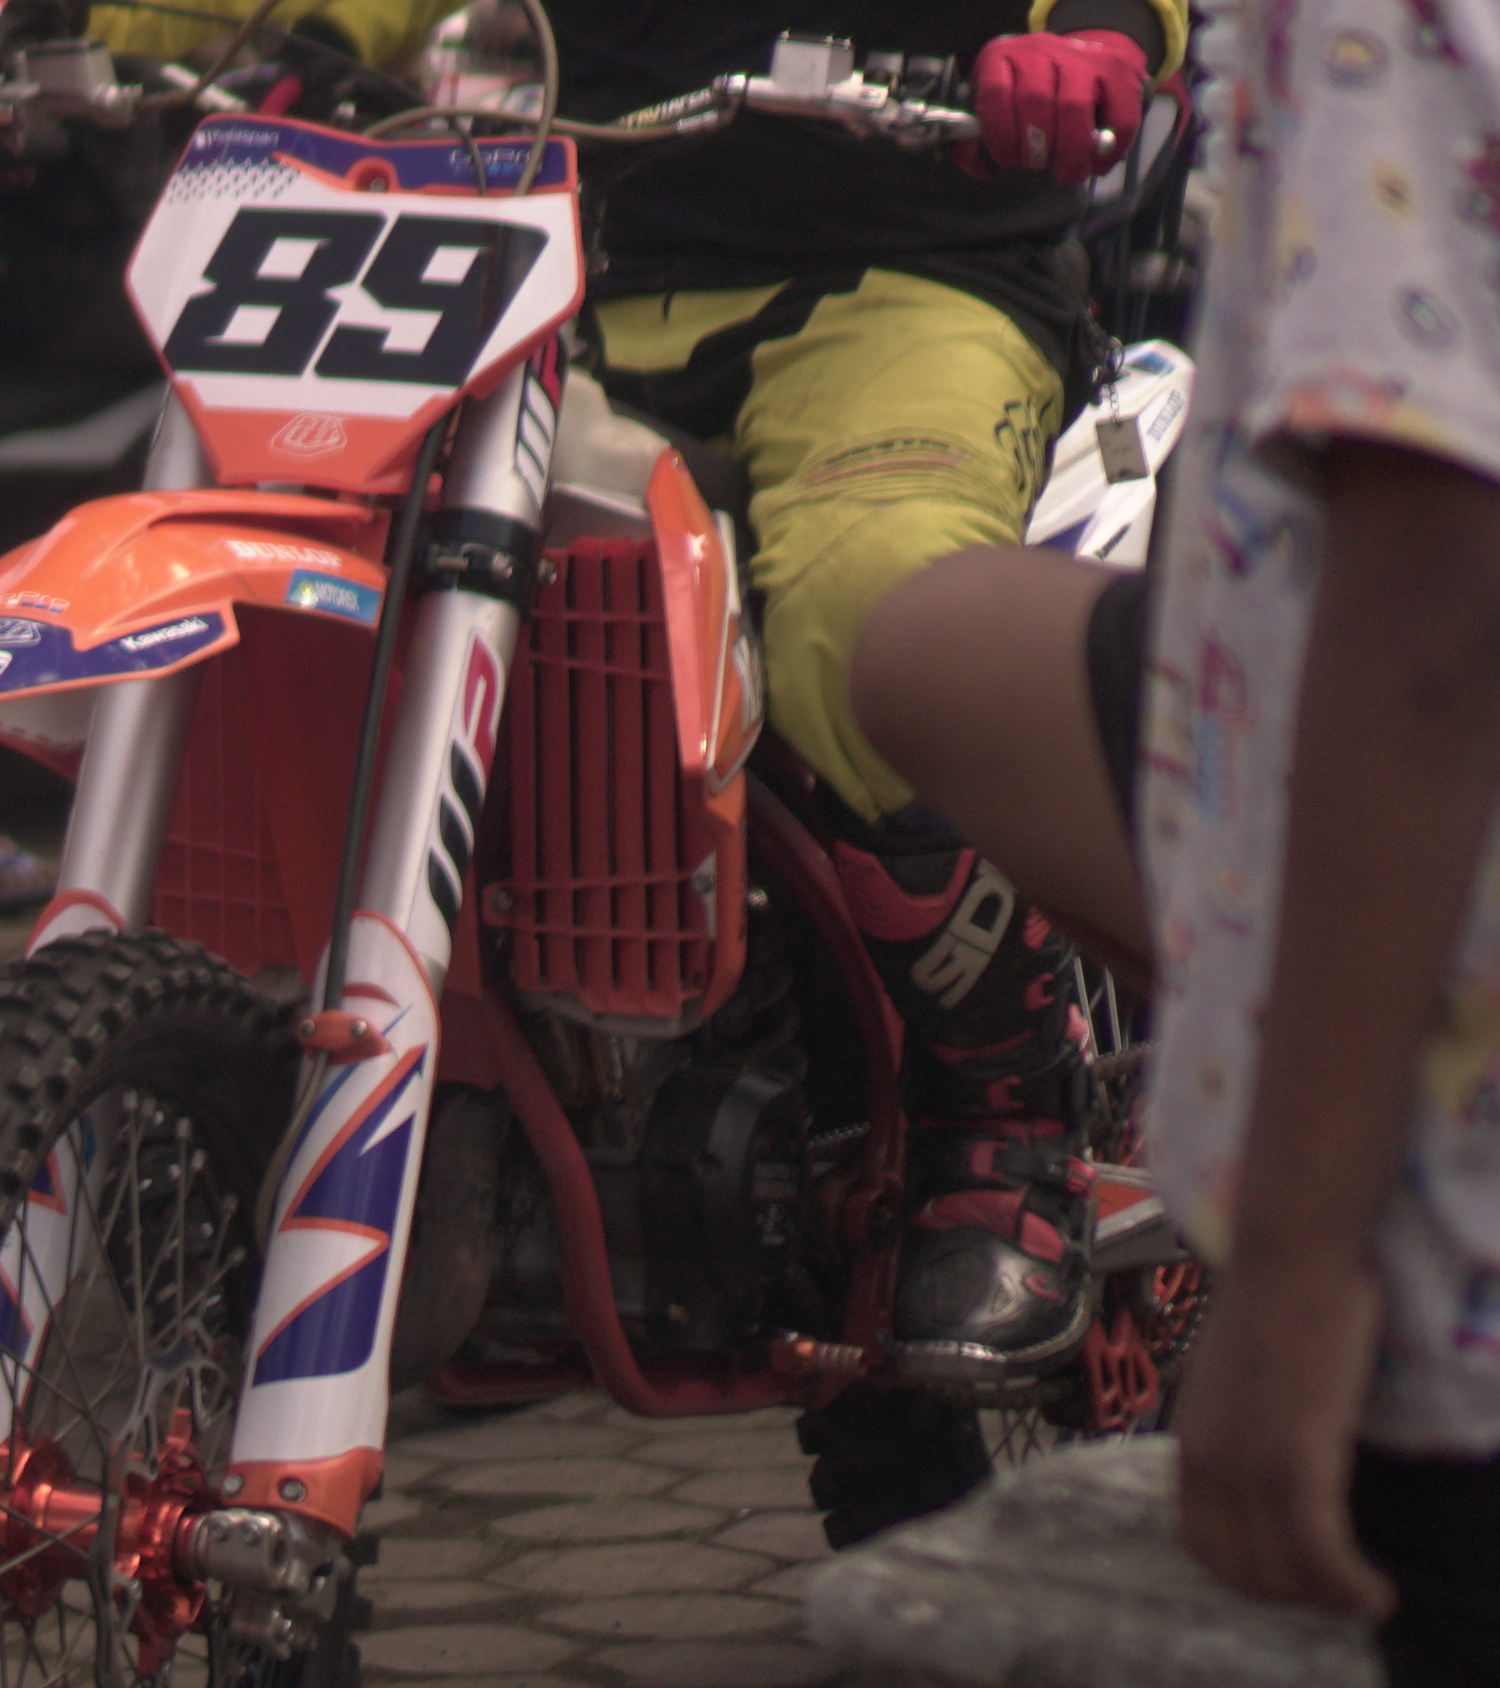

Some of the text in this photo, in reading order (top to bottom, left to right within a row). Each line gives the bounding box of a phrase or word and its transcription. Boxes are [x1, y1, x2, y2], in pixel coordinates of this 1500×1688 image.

[164, 206, 550, 388] 89
[225, 540, 343, 569] DUNLOP
[120, 615, 210, 654] Kawasaki
